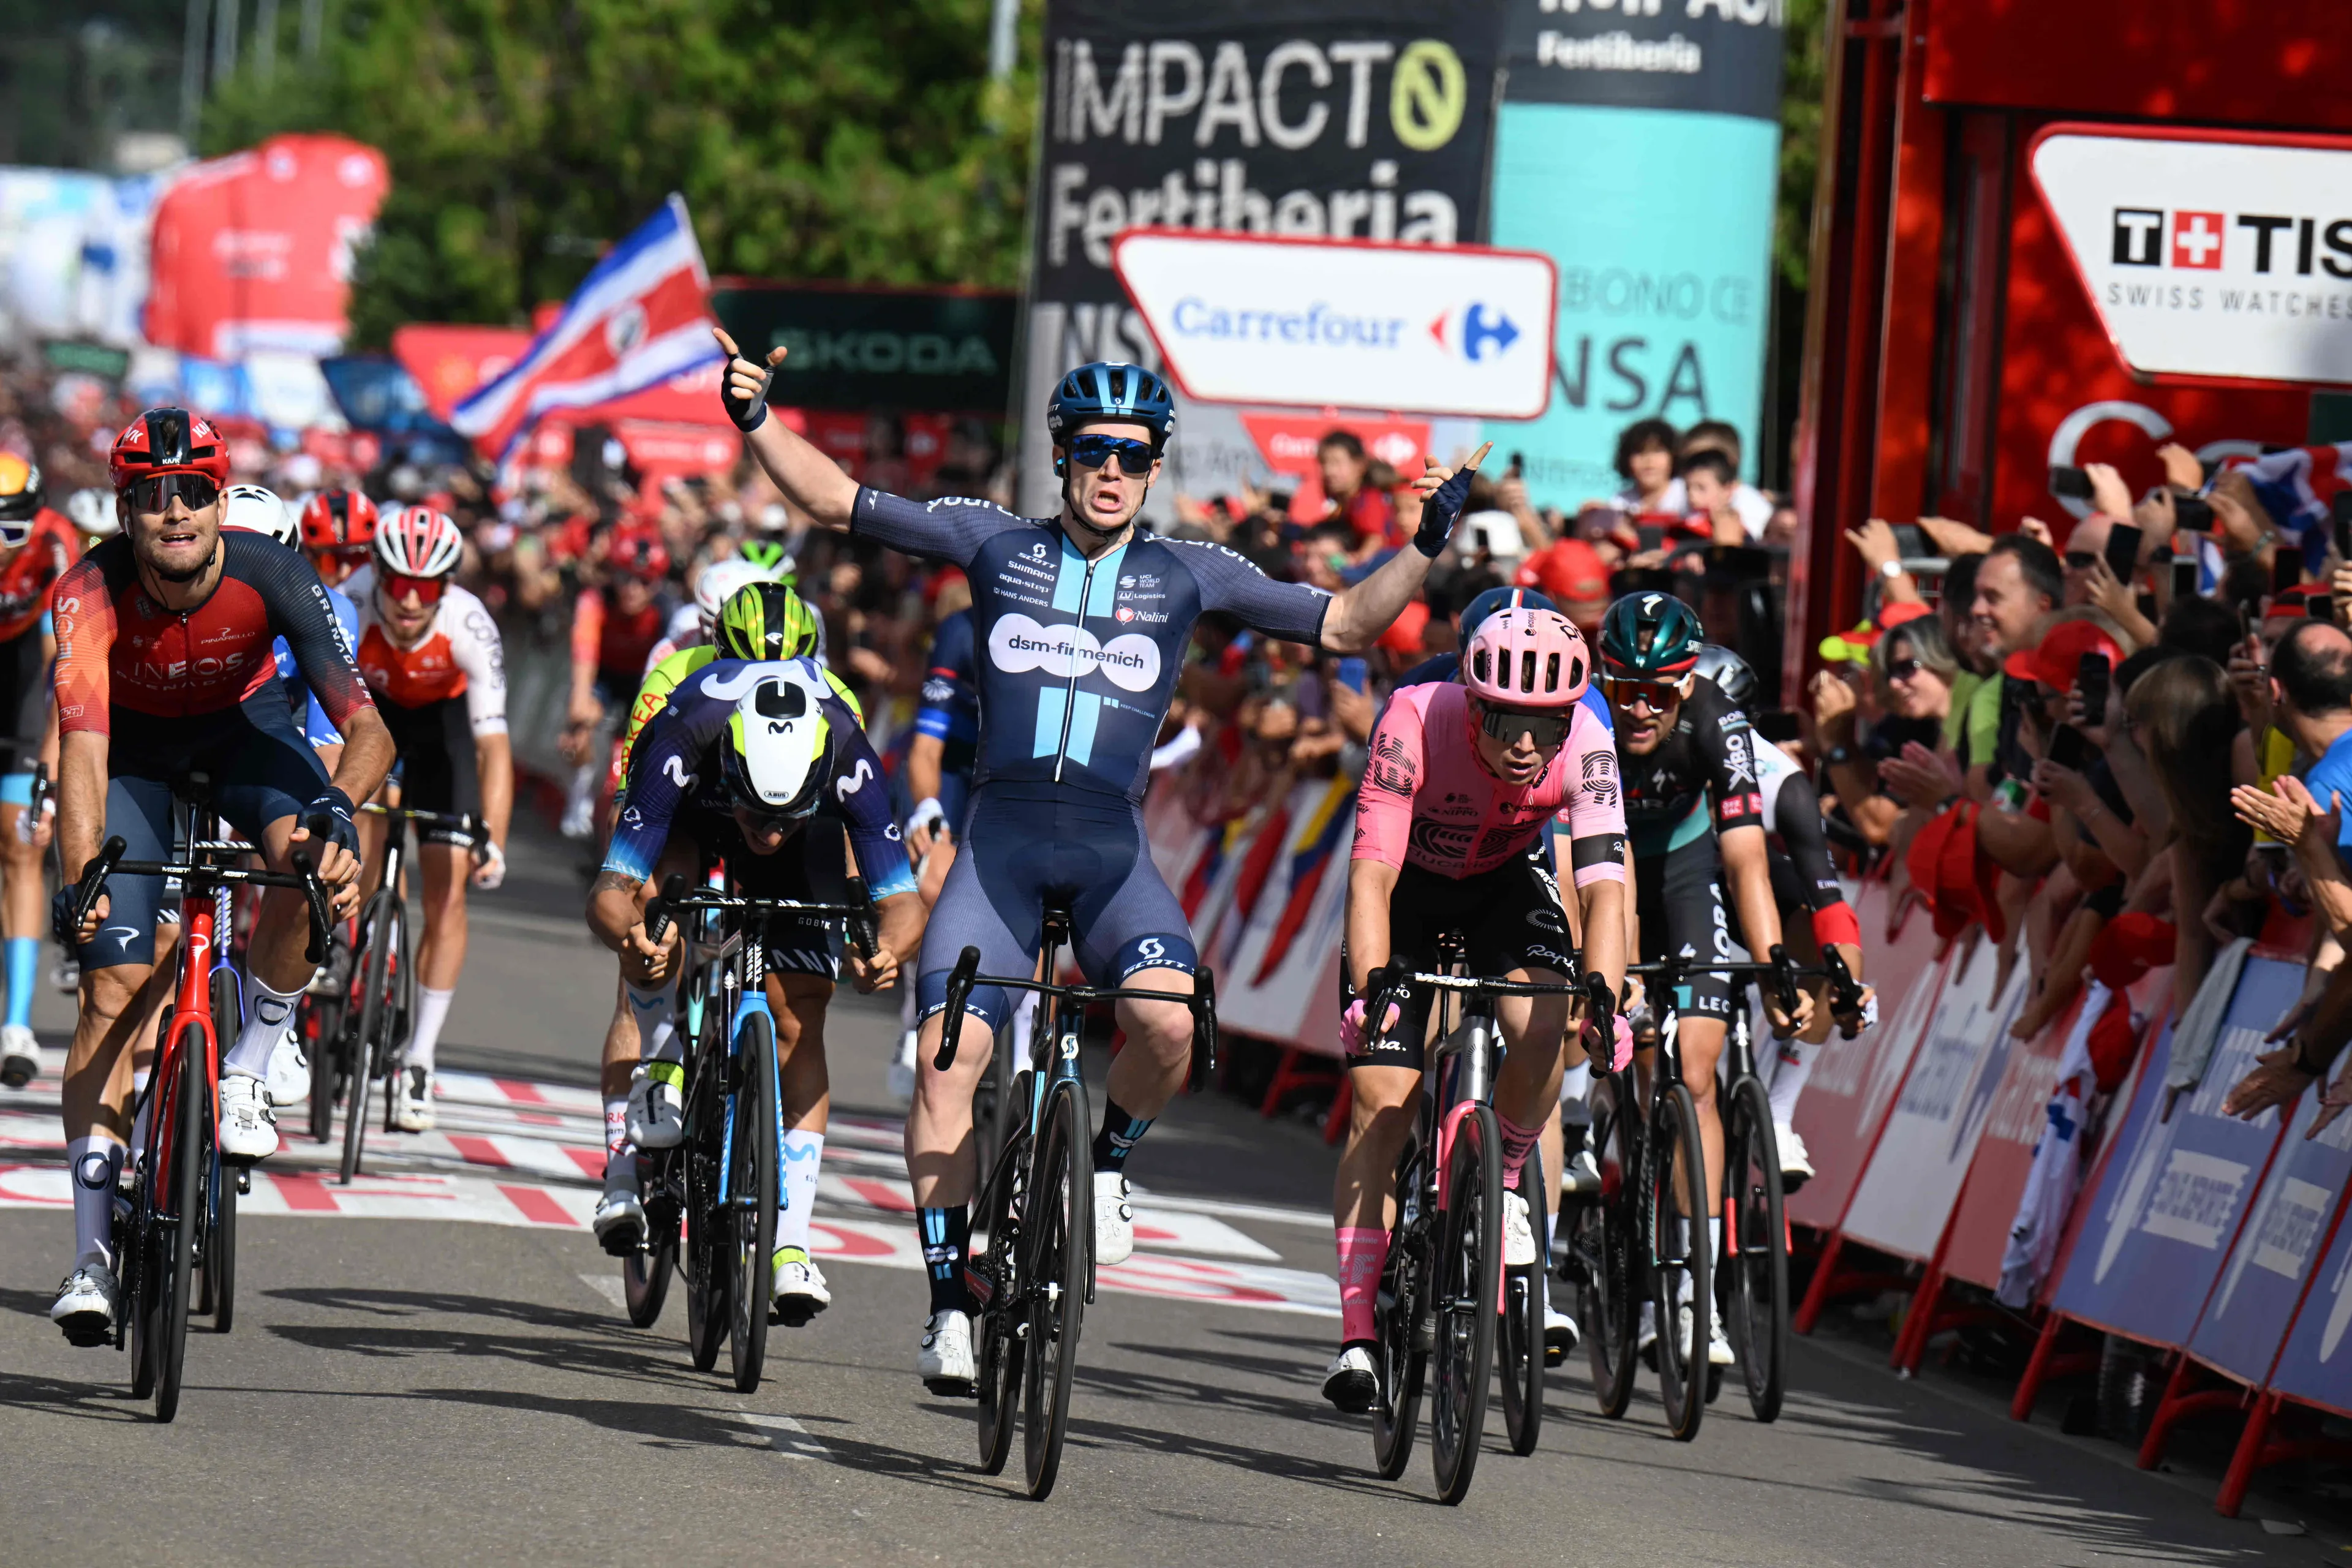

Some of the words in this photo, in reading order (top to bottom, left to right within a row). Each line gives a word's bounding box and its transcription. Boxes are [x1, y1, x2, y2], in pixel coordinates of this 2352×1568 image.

[2108, 282, 2204, 309] SWISS
[1172, 296, 1403, 348] Carrefour
[1017, 552, 1057, 568] SCOTT
[1008, 560, 1055, 582] SHIMANO
[1000, 589, 1017, 600] HANS
[1018, 595, 1049, 607] ANDERS
[1136, 611, 1169, 623] Nalini
[201, 631, 255, 645] PINARELLO
[134, 652, 245, 680] INEOS
[798, 917, 831, 930] GOBIK
[1122, 959, 1187, 978] SCOTT
[928, 1001, 989, 1016] SCTT
